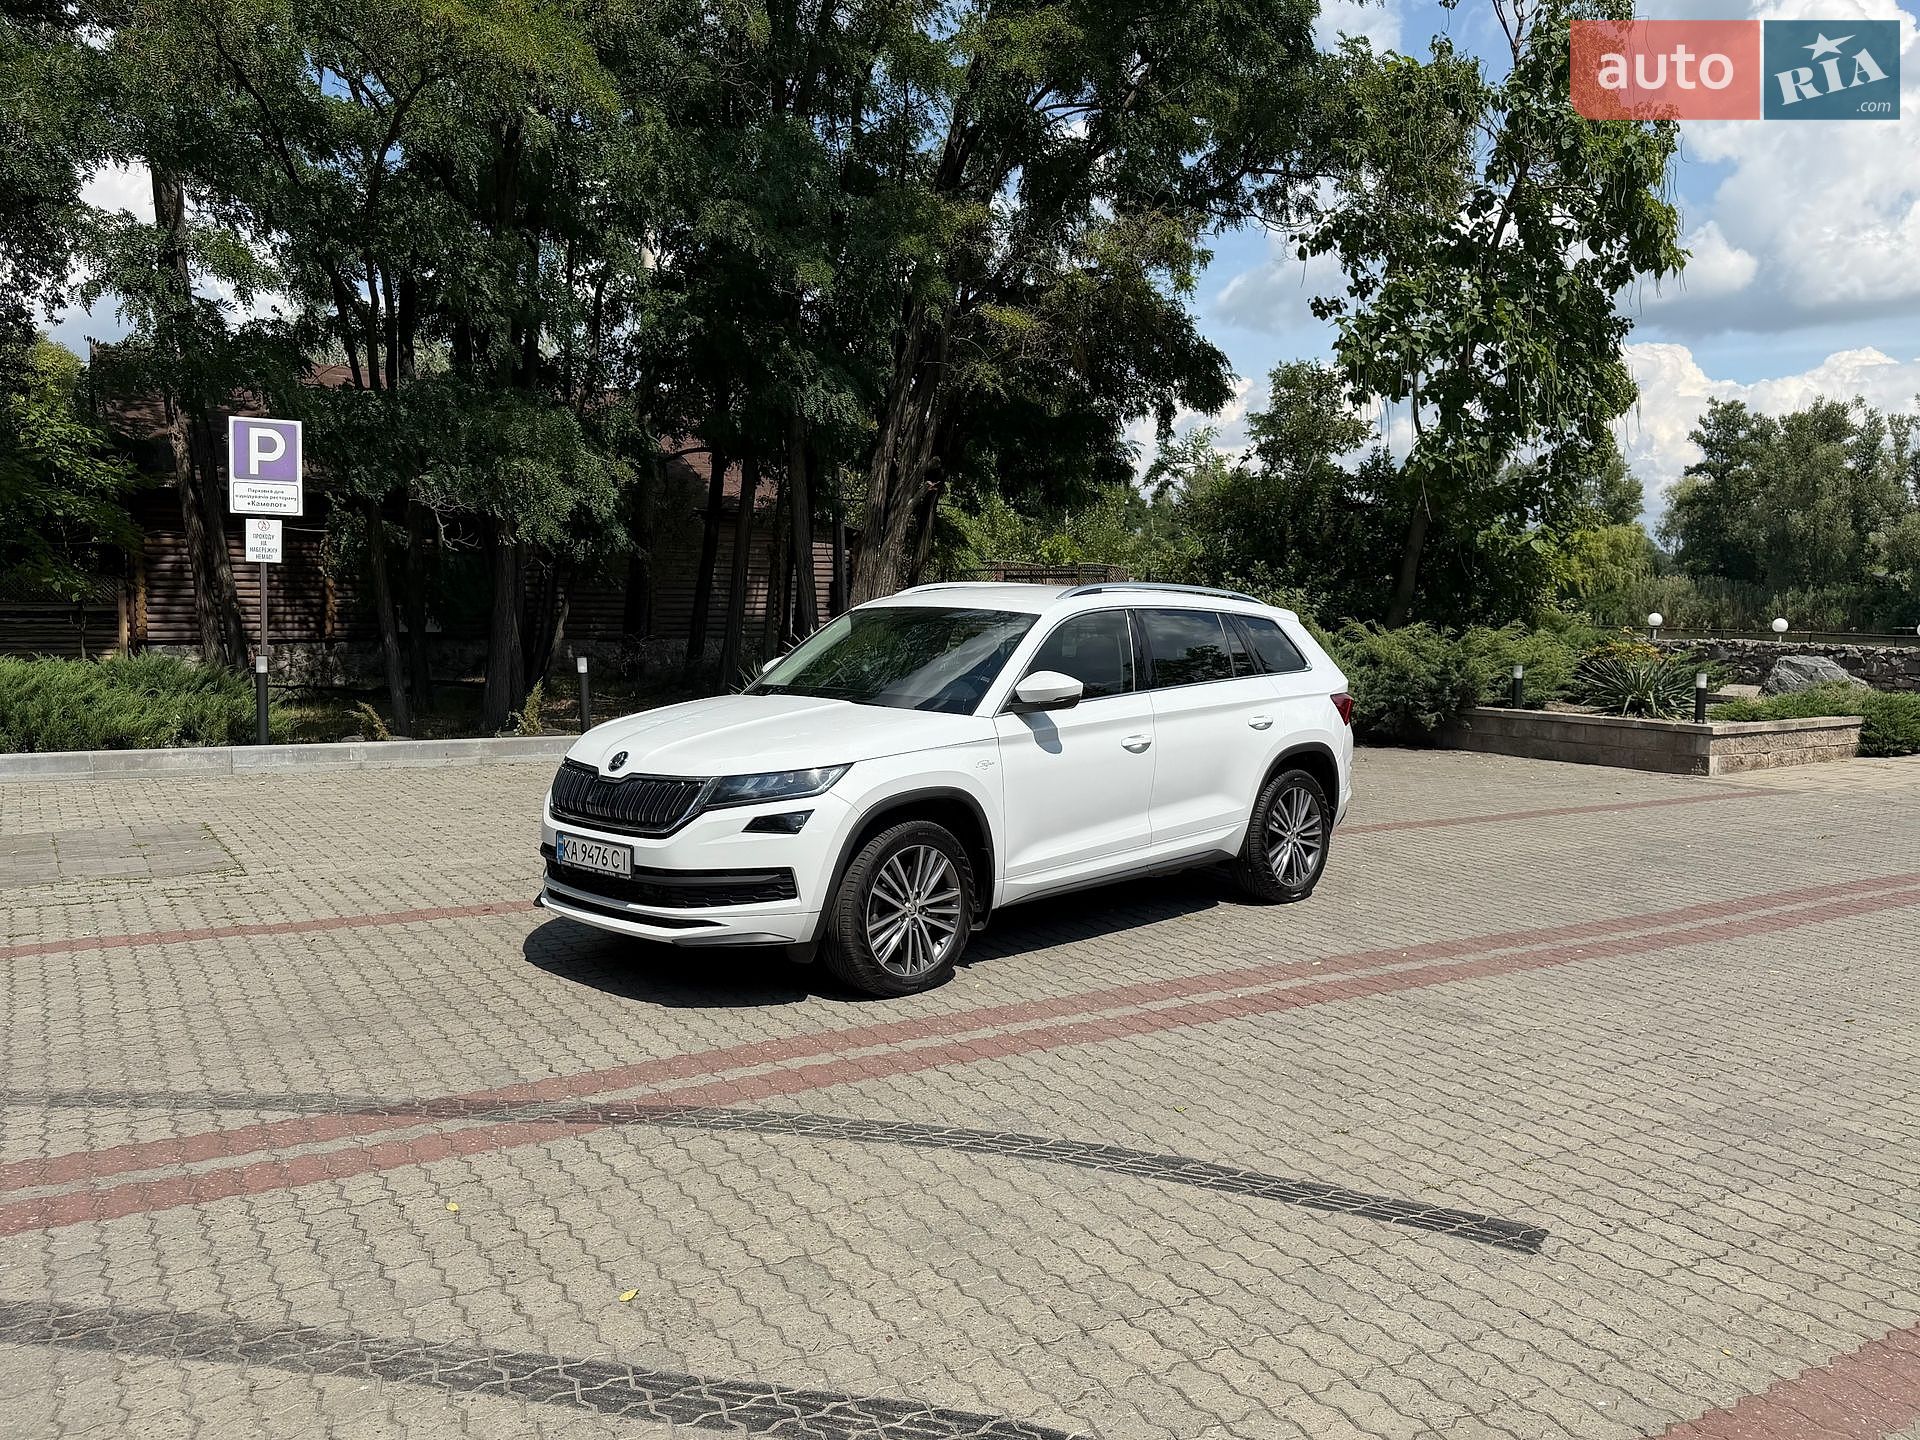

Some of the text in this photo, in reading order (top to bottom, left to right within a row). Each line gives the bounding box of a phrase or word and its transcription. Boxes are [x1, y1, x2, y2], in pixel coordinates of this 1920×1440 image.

[249, 427, 286, 475] P
[563, 839, 578, 861] KA
[581, 843, 609, 867] 9476
[611, 850, 626, 872] CI
